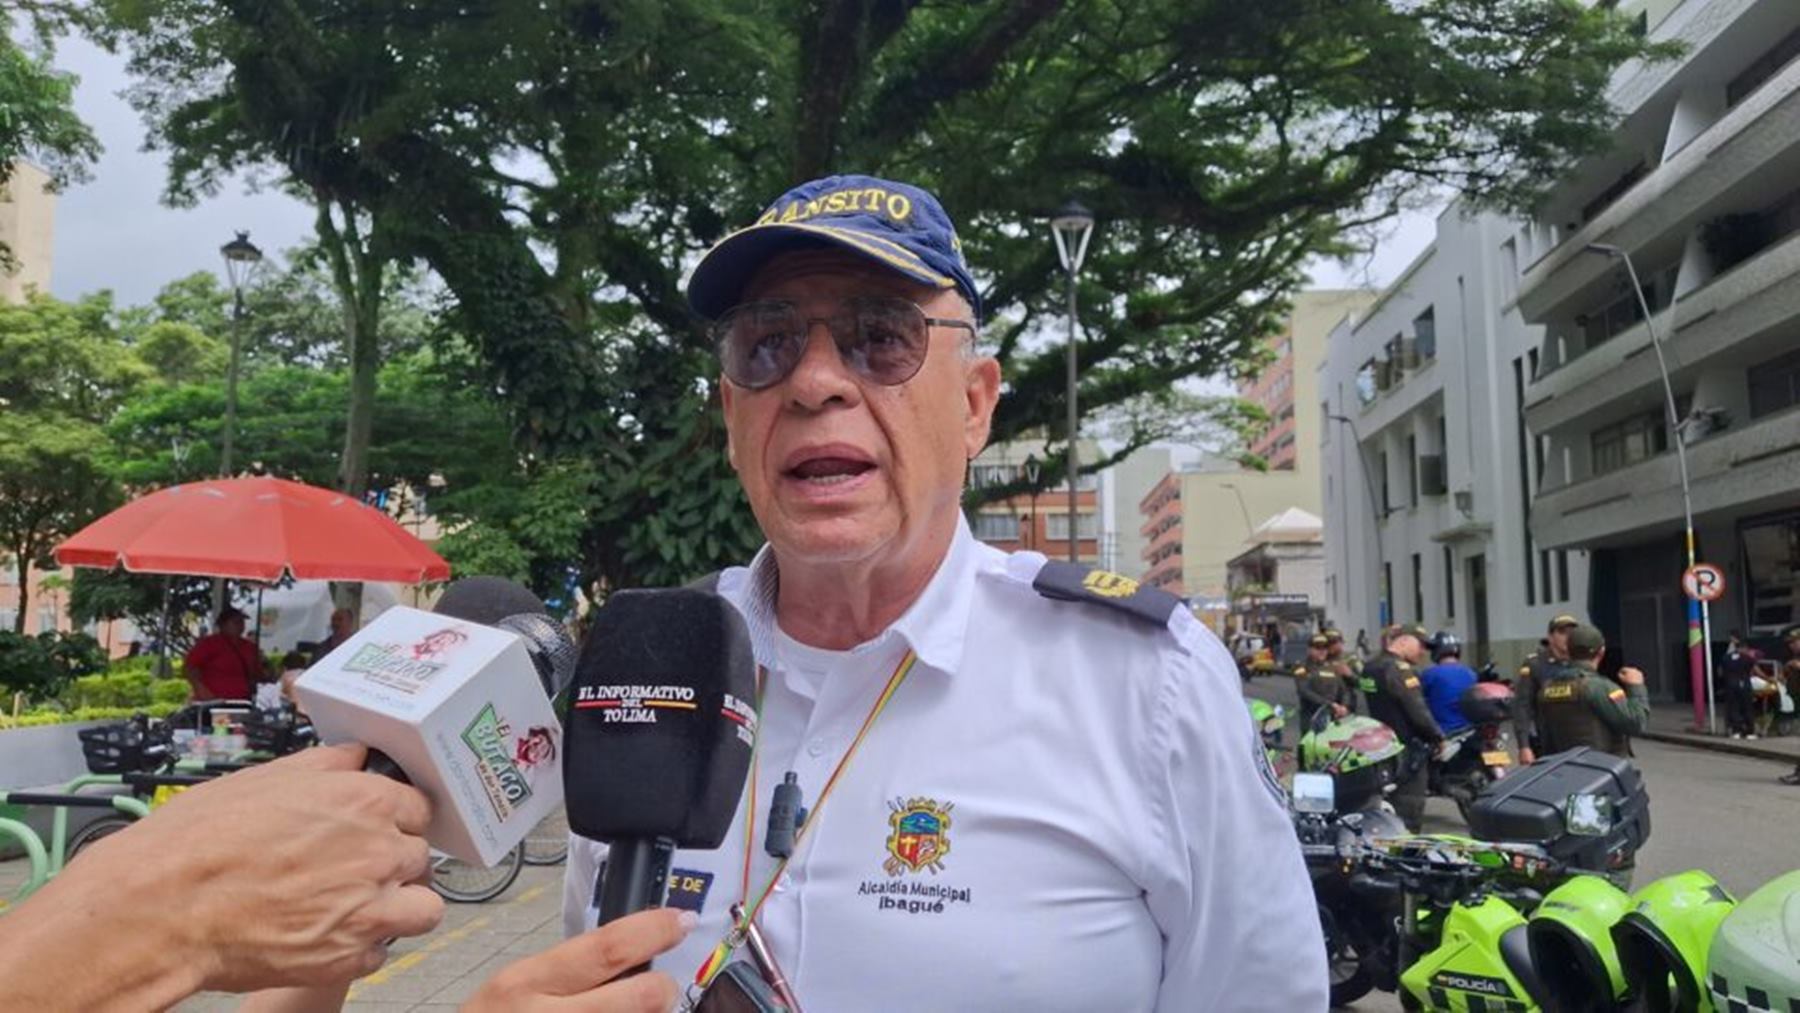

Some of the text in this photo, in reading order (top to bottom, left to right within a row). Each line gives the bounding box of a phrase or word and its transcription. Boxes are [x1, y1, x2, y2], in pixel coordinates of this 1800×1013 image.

[578, 686, 694, 700] EL INFORMATIVO
[621, 698, 643, 708] DEL
[604, 709, 657, 723] TOLIMA
[476, 722, 522, 801] BUTACO
[682, 877, 705, 893] DE
[858, 881, 971, 903] Alcaldía Municipal
